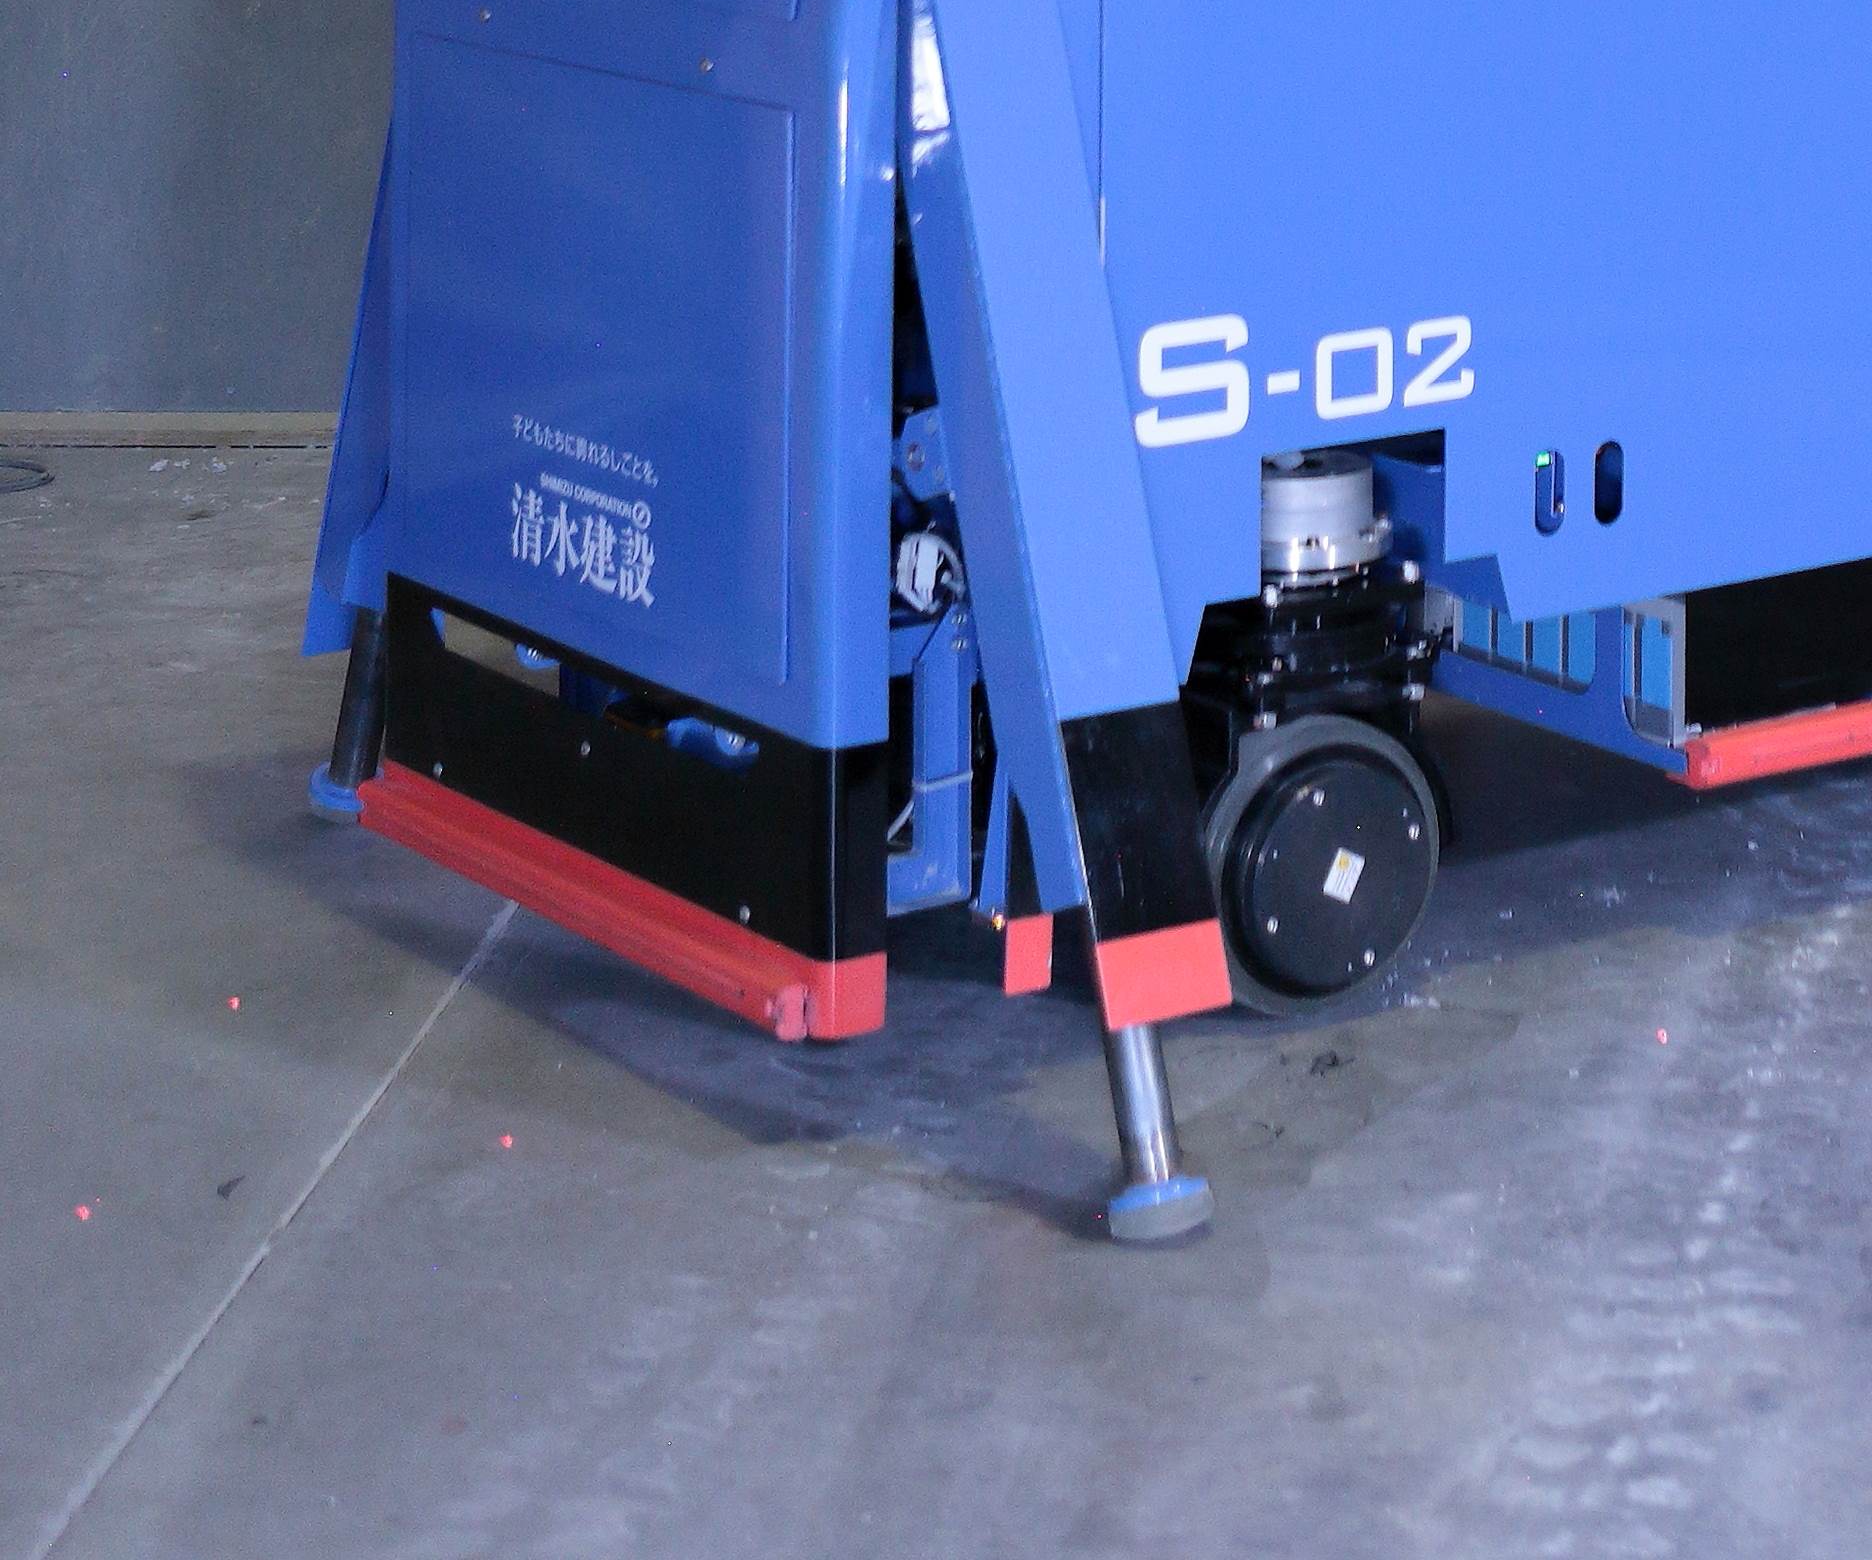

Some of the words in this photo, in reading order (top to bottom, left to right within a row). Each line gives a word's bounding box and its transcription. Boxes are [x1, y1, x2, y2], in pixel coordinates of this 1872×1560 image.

[1134, 314, 1475, 448] S-02
[511, 482, 656, 608] 清水建設
